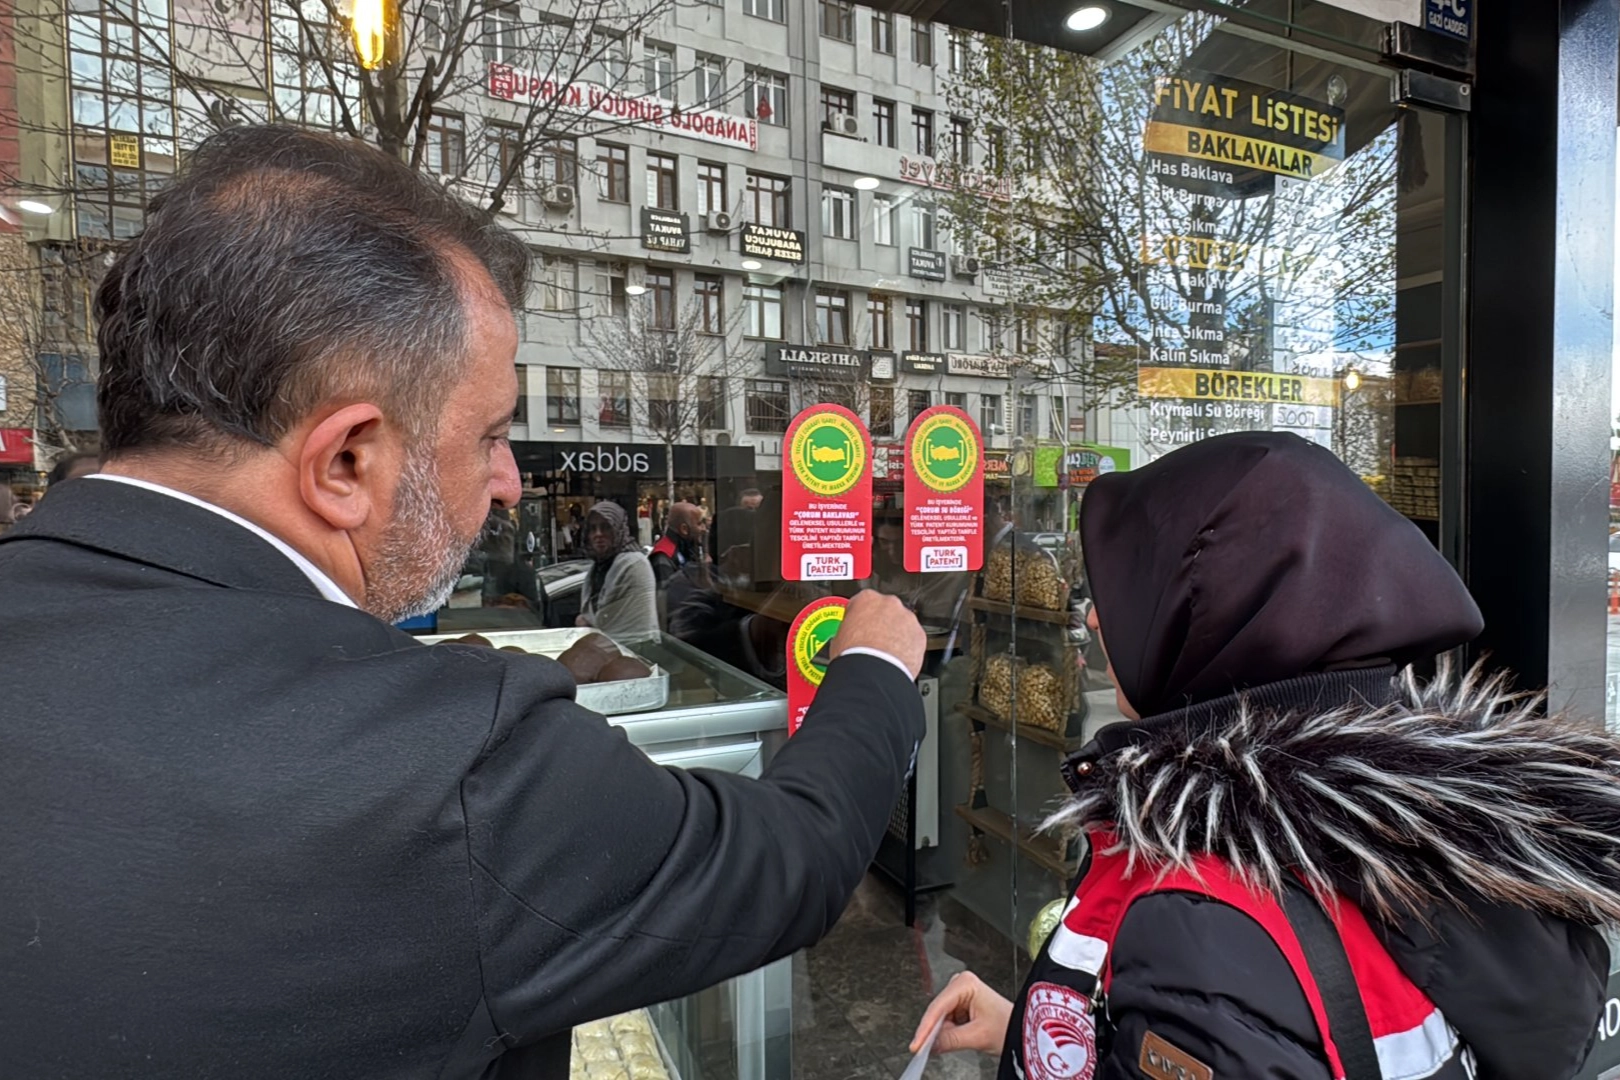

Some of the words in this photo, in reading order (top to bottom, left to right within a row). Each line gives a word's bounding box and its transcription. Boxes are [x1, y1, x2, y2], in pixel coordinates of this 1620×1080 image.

[1187, 130, 1313, 177] BAKLAVALAR
[1151, 158, 1178, 177] Has
[1181, 163, 1234, 185] Baklava
[1184, 324, 1224, 341] Sıkma
[1190, 349, 1231, 365] Sıkma
[1195, 372, 1303, 402] BÖREKLER
[1150, 401, 1202, 420] Kıymalı
[1205, 403, 1221, 417] Su
[1225, 404, 1265, 422] Böreği
[1150, 427, 1205, 445] Peynirli
[811, 565, 844, 574] PATENT
[930, 557, 959, 565] PATENT
